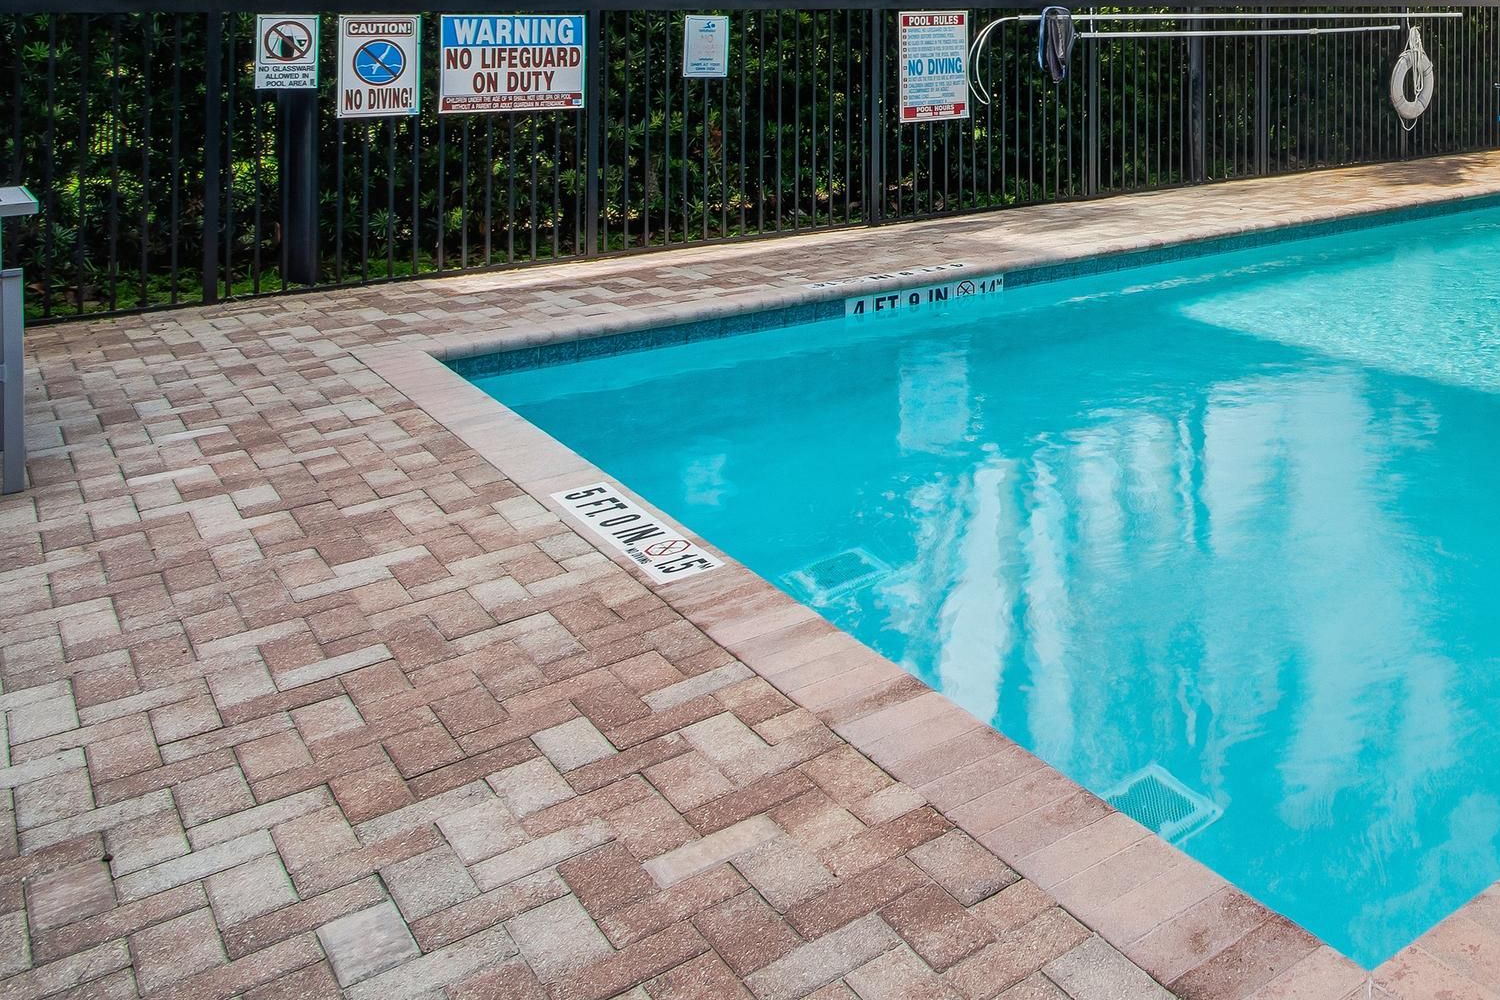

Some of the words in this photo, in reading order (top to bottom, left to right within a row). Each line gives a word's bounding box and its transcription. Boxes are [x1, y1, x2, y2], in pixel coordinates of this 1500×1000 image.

[350, 23, 412, 34] CAUTION!
[453, 18, 574, 45] WARNING
[908, 16, 931, 26] POOL
[933, 15, 959, 25] RULES
[446, 48, 472, 70] NO
[481, 47, 581, 69] LIFEGUARD
[908, 59, 924, 76] NO
[927, 57, 965, 75] DIVING.
[472, 71, 498, 93] ON
[506, 71, 555, 92] DUTY
[345, 89, 362, 111] NO
[368, 88, 413, 110] DIVING!
[853, 300, 865, 314] 4
[876, 295, 899, 311] FT
[929, 287, 949, 302] IN
[564, 486, 607, 500] 5
[599, 514, 641, 527] 0
